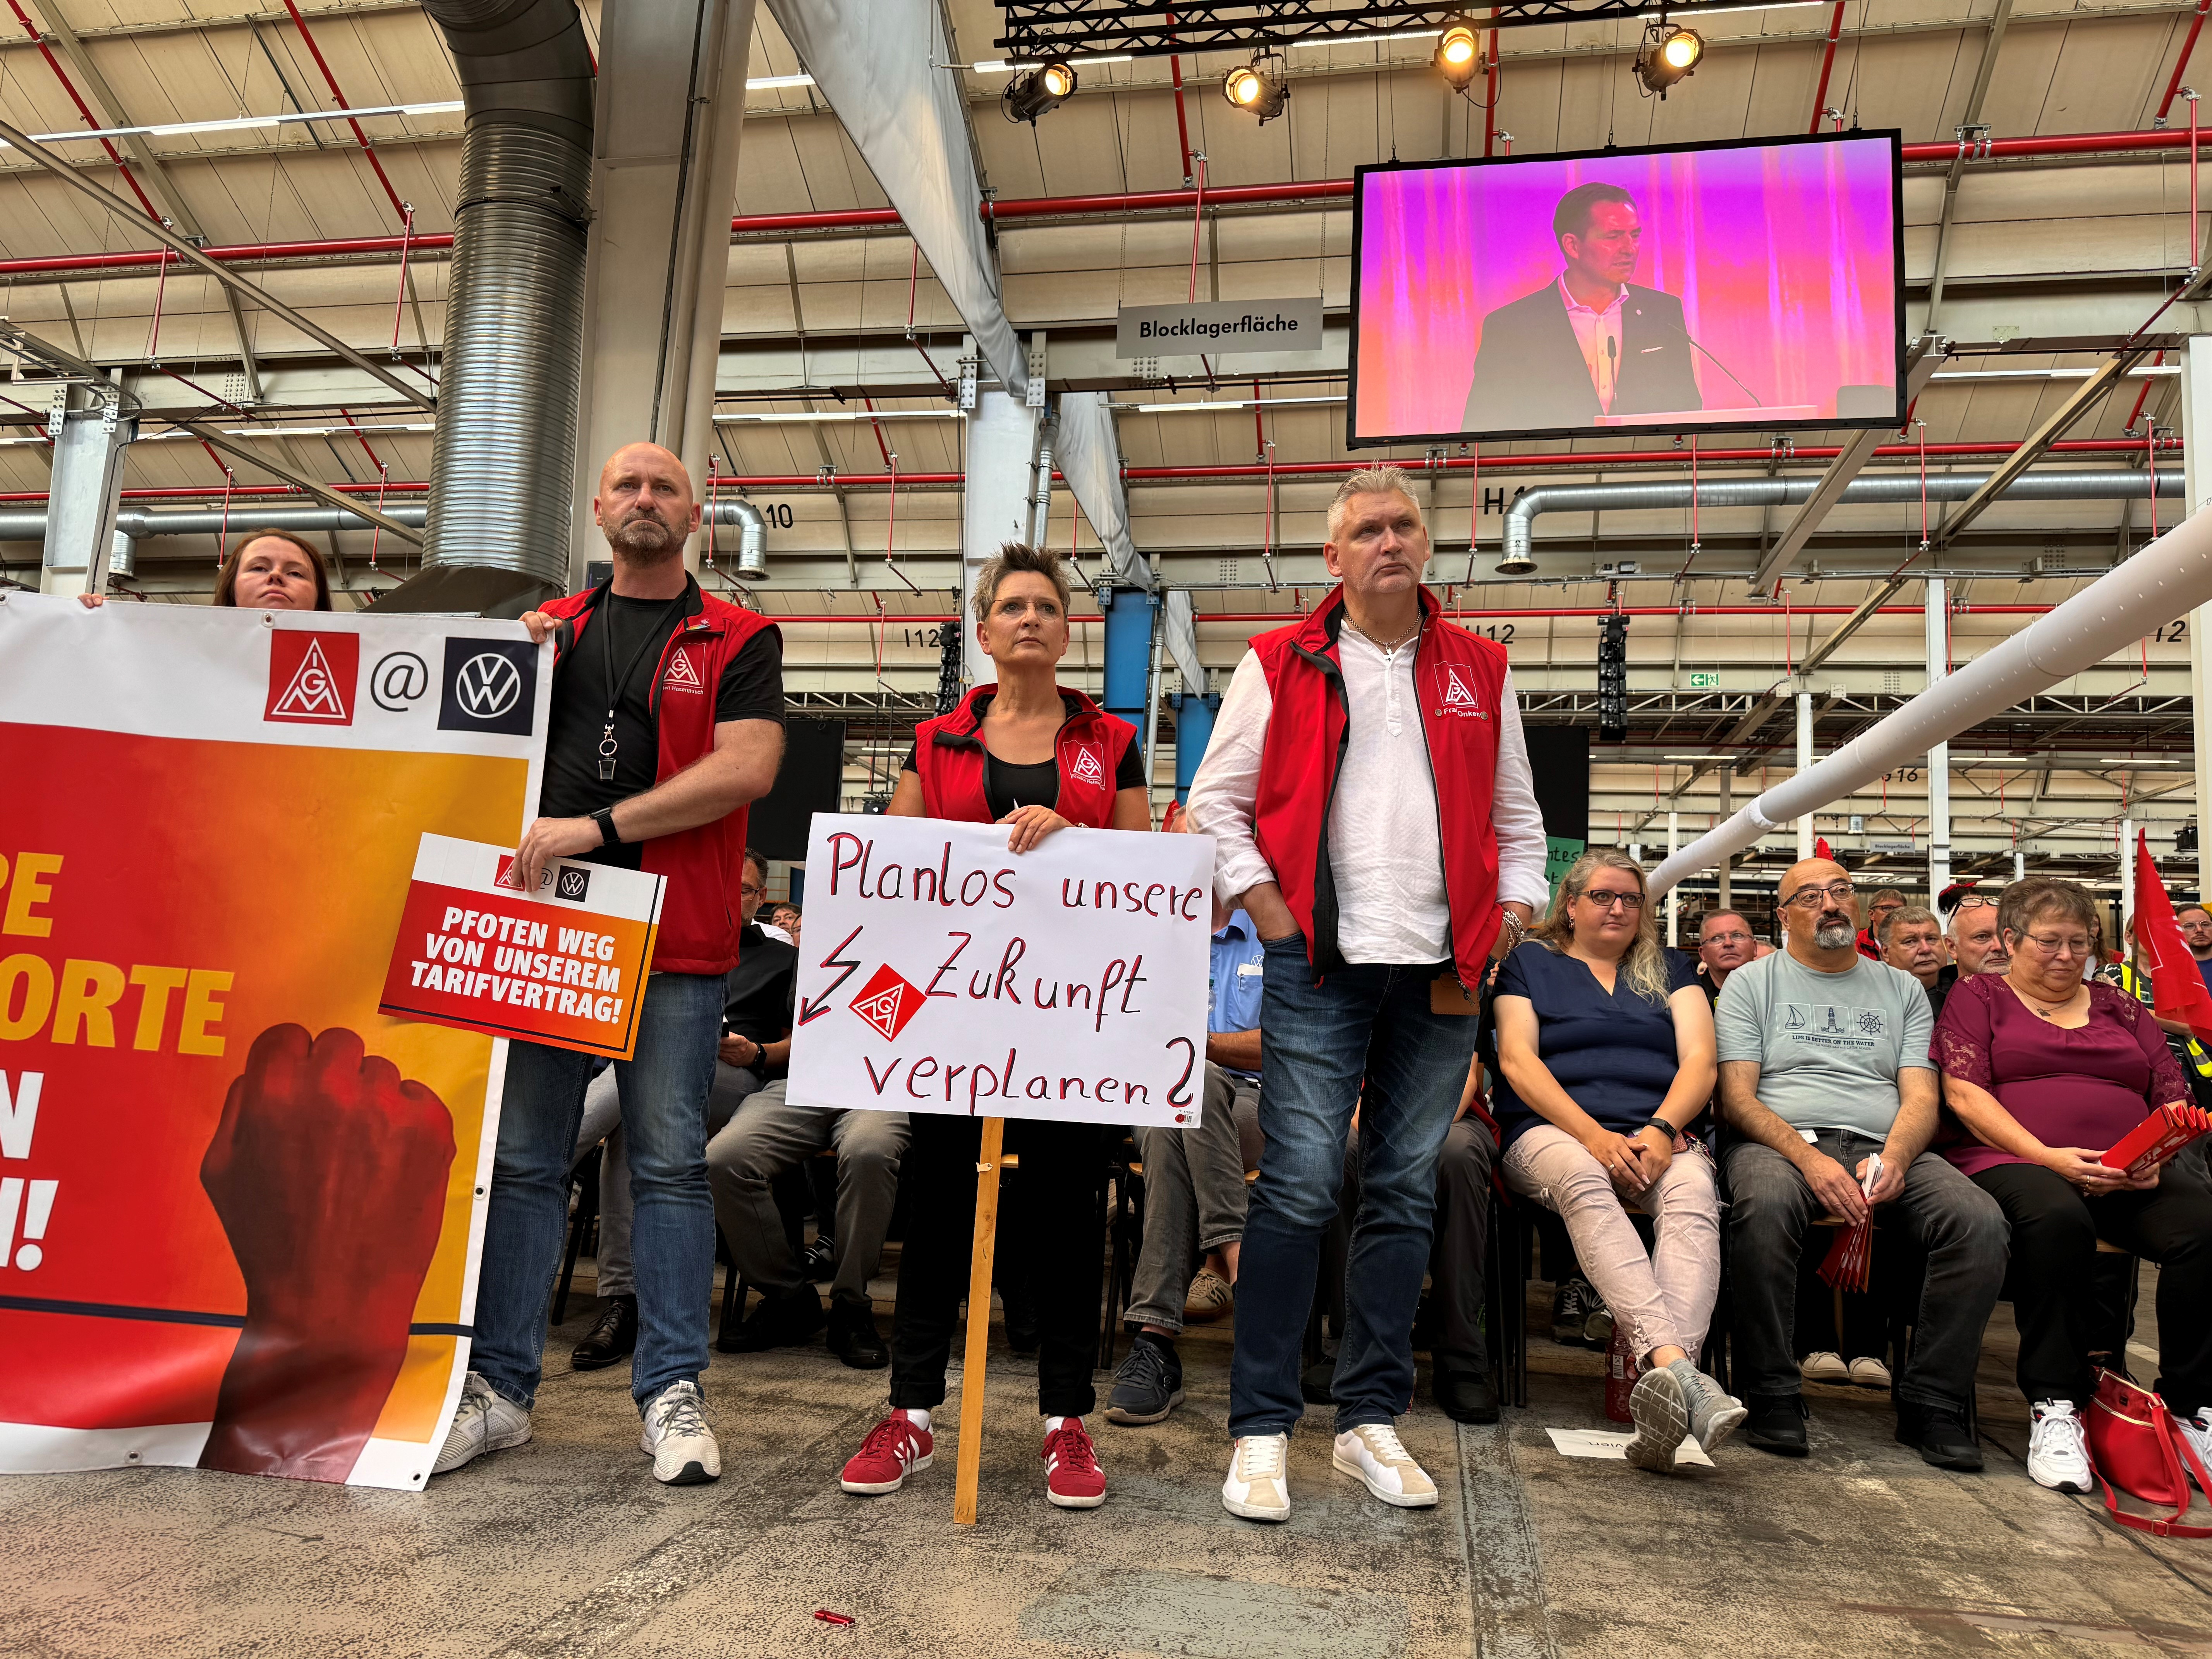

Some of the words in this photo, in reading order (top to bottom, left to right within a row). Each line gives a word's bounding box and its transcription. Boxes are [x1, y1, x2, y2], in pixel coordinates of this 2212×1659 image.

[1140, 314, 1298, 338] Blocklagerfläche
[752, 503, 793, 529] 10
[370, 651, 428, 712] @
[457, 653, 520, 718] VW
[0, 852, 64, 938] E
[827, 832, 1015, 908] Planlos
[1062, 878, 1203, 921] unsere
[426, 933, 485, 967] VON
[494, 946, 620, 993] UNSEREM
[441, 907, 548, 948] PFOTEN
[558, 927, 615, 961] WEG
[411, 961, 623, 1024] TARIFVERTRAG!
[925, 932, 1147, 1032] Zukunft
